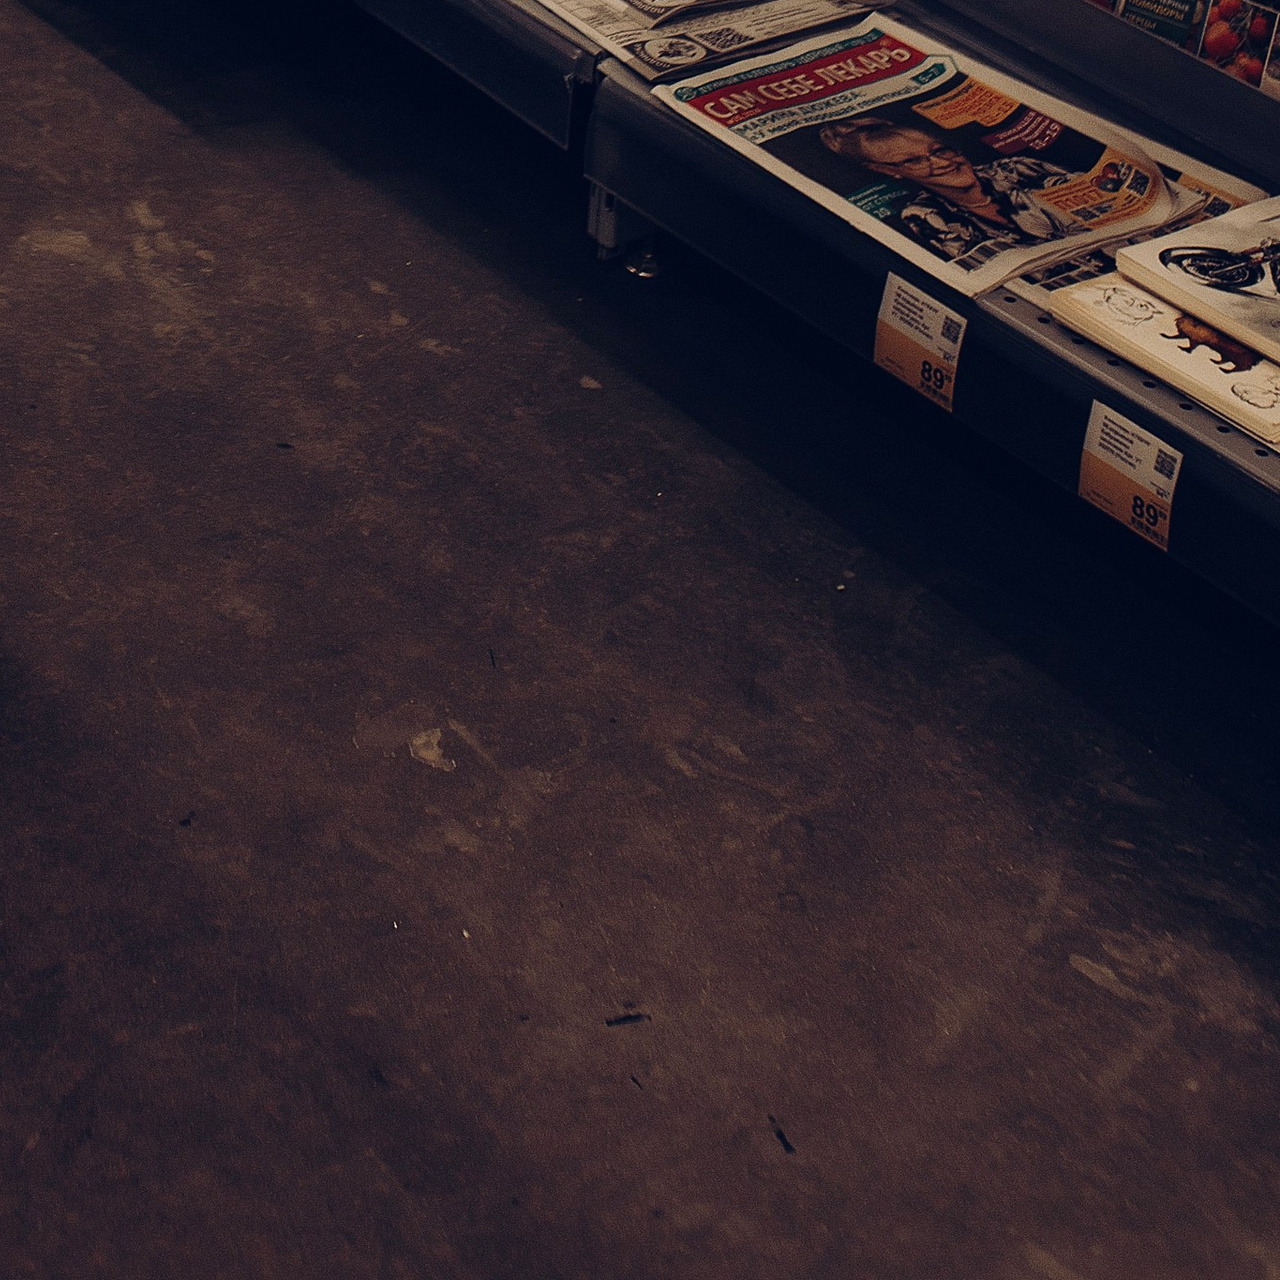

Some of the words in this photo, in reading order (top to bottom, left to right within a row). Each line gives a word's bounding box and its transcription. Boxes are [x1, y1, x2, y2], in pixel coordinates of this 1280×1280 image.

[703, 86, 763, 121] САМ
[761, 71, 826, 106] СЕБЕ
[821, 45, 913, 87] ЛЕКАРЬ
[735, 107, 795, 139] МАРИНА
[921, 359, 945, 390] 89
[1131, 495, 1158, 527] 89
